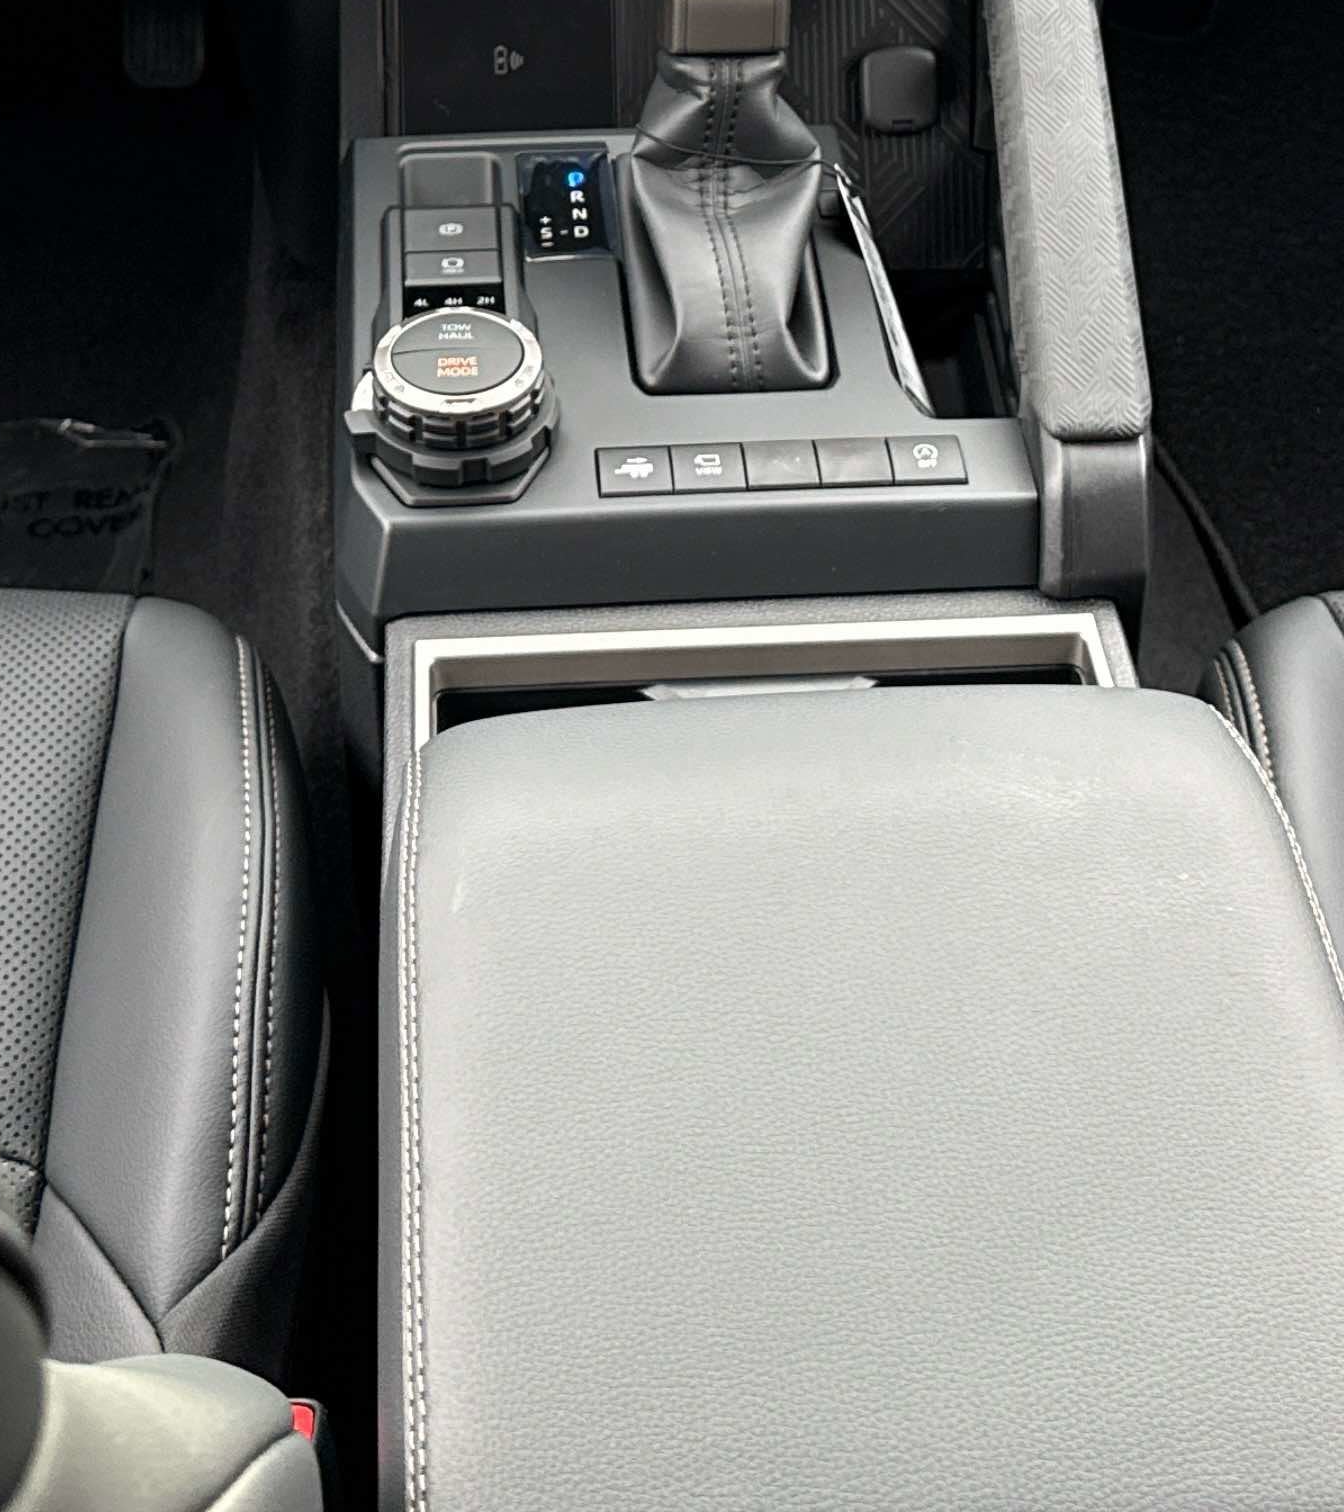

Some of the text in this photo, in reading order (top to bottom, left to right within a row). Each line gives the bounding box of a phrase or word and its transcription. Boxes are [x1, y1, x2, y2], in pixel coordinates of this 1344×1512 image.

[570, 190, 586, 203] R
[572, 207, 587, 220] N
[540, 225, 589, 239] S D
[441, 323, 471, 332] TOW
[437, 356, 478, 367] DRIVE
[436, 366, 479, 378] MODE
